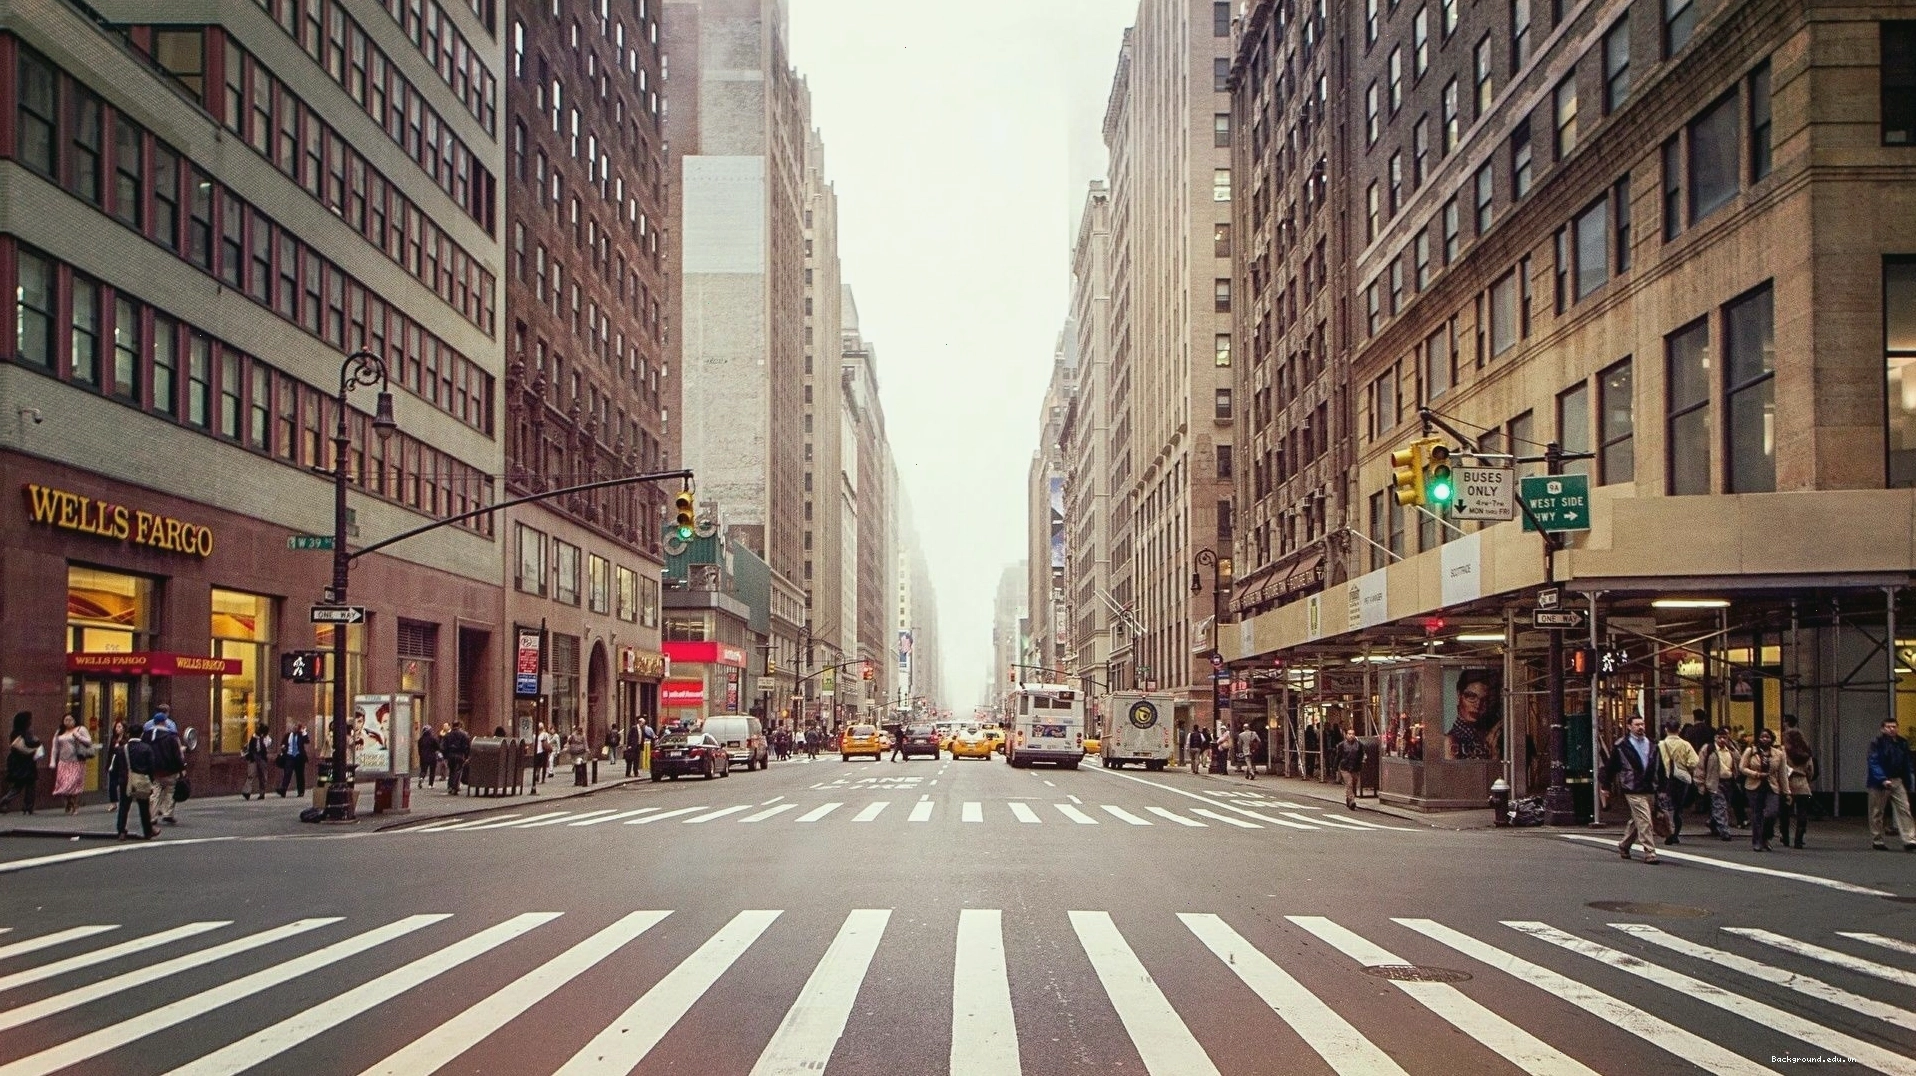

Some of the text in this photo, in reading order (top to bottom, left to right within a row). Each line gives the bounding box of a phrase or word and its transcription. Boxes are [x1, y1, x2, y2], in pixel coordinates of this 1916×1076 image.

[1463, 471, 1503, 483] BUSES
[1467, 485, 1498, 497] ONLY
[1529, 496, 1584, 509] WEST SIDE
[28, 483, 214, 558] WELLS FARGO
[299, 537, 307, 548] W
[317, 610, 356, 620] ONE WAY
[1541, 614, 1577, 623] ONE WAY
[75, 656, 147, 665] WELLS FARGO
[175, 656, 226, 672] WELLS FARGO
